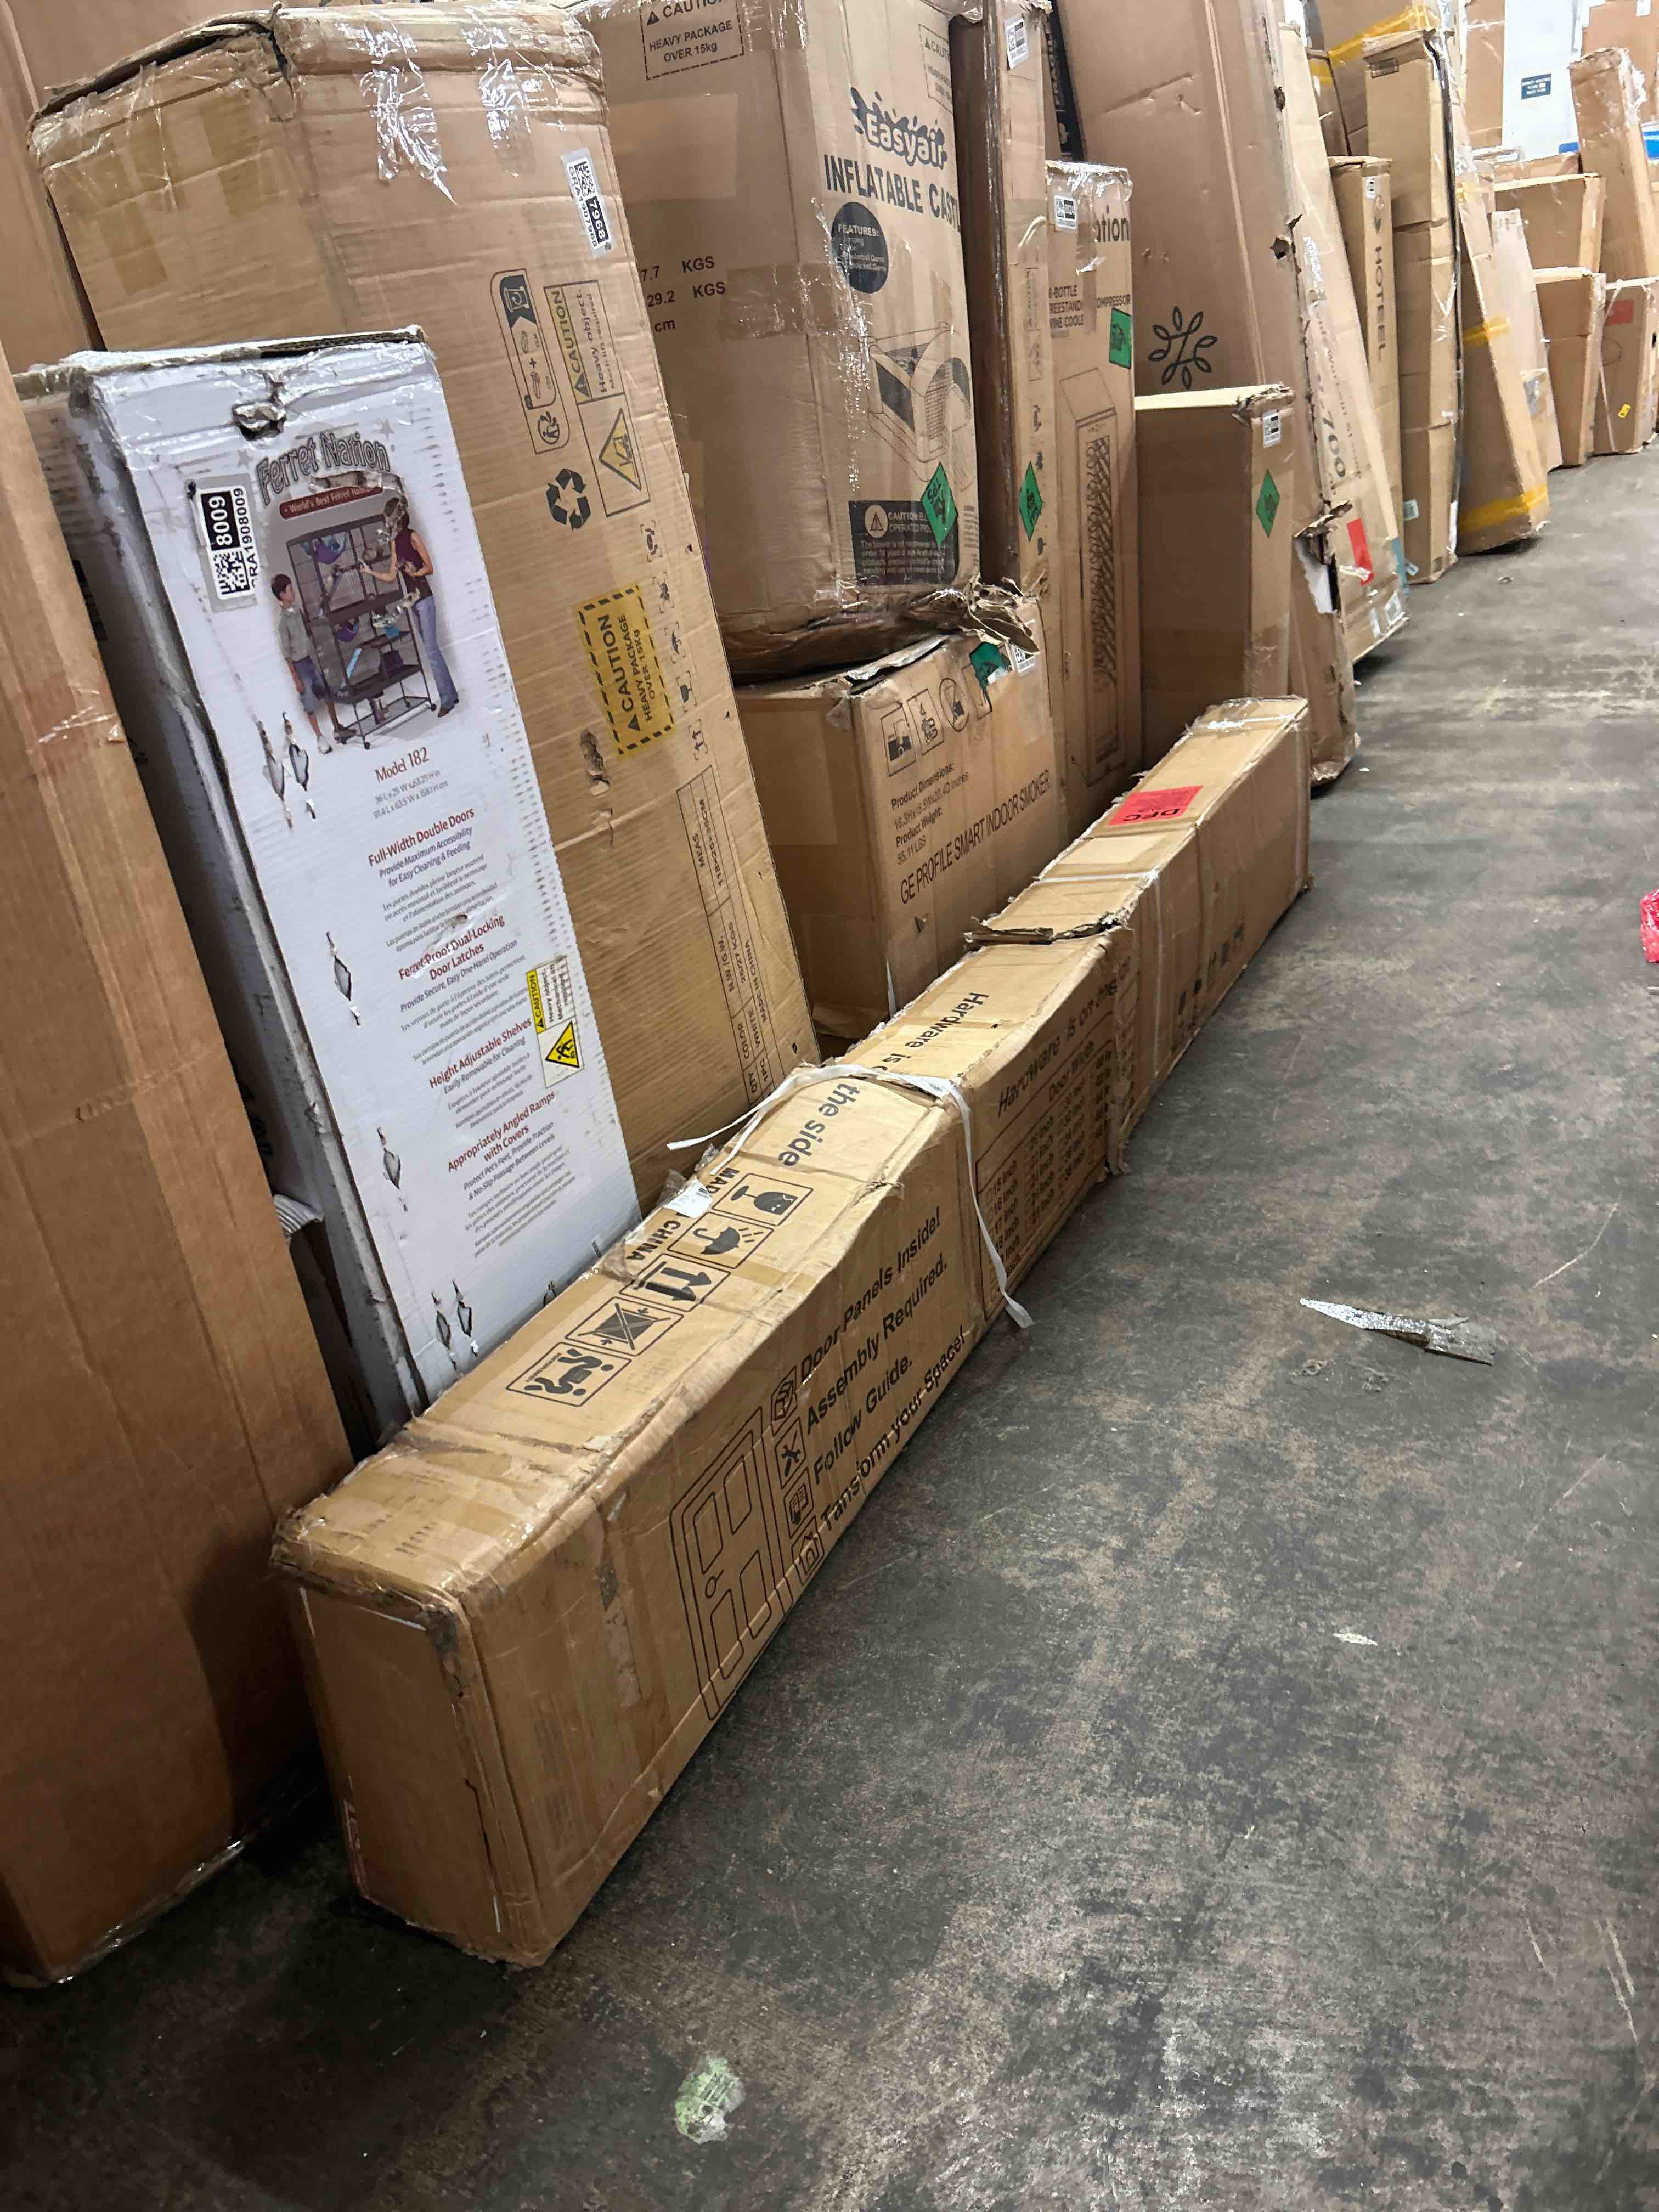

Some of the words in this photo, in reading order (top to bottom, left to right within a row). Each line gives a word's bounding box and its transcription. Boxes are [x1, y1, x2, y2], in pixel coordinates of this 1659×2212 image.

[663, 0, 726, 18] CAUTI
[649, 34, 681, 52] HEAVY
[684, 20, 732, 41] PACKAGE
[663, 48, 692, 62] OVER
[695, 42, 718, 54] 15kg
[931, 41, 949, 61] CAUT
[864, 110, 947, 170] Easyair
[568, 165, 599, 249] GRA1907968
[824, 154, 923, 213] INFLATABLE
[929, 183, 962, 232] CASTL
[589, 200, 607, 241] 7968
[838, 224, 879, 237] FEATURES:
[682, 256, 715, 273] KGS
[646, 290, 675, 308] 29.2
[693, 281, 726, 298] KGS
[1049, 300, 1080, 315] REESTAND
[1097, 294, 1131, 308] OMPRESSOR
[551, 290, 582, 375] CAUTION
[654, 320, 675, 332] cm
[1065, 314, 1084, 327] COOL
[588, 346, 608, 393] Heavy
[256, 437, 319, 506] Ferret
[320, 431, 391, 472] Nation
[208, 495, 232, 546] 8009
[596, 613, 635, 713] CAUTION
[617, 614, 640, 676] PACKAGE
[634, 678, 653, 721] HEAVY
[641, 664, 656, 699] OVER
[375, 759, 407, 783] Model
[409, 747, 430, 768] 182
[891, 786, 919, 811] Product
[368, 835, 417, 867] Full-Width
[416, 820, 449, 843] Double
[449, 808, 475, 830] Doors
[378, 858, 404, 878] Provide
[403, 843, 437, 866] Maximum
[436, 825, 473, 851] Accessibility
[692, 832, 706, 868] MEAS
[896, 822, 921, 848] Product
[900, 875, 915, 905] GE
[916, 842, 953, 892] PROFILE
[955, 818, 985, 861] SMART
[986, 799, 1018, 835] INDOOR
[1019, 769, 1051, 812] SMOKER
[387, 875, 399, 888] for
[398, 867, 414, 883] Easy
[413, 854, 442, 876] Cleaning
[446, 839, 471, 859] Feeding
[450, 913, 506, 953] Dual-Locking
[399, 991, 425, 1012] Provide
[445, 971, 461, 986] Easy
[489, 939, 518, 962] Operation
[428, 960, 452, 980] Door
[451, 941, 485, 968] Latches
[744, 939, 758, 976] CHINA
[528, 974, 541, 1018] CAUTION
[752, 976, 760, 989] IN
[755, 989, 768, 1022] MADE
[905, 992, 989, 1048] Hardware
[736, 1021, 751, 1059] COLOR
[747, 1008, 761, 1048] WHITE
[428, 1063, 459, 1090] Height
[458, 1036, 502, 1071] Adjustable
[501, 1017, 533, 1045] Shelves
[758, 1057, 769, 1082] 1PC
[883, 1053, 912, 1063] is
[997, 1036, 1060, 1116] Hardware
[817, 1083, 860, 1118] the
[446, 1126, 504, 1175] Appropriately
[501, 1107, 531, 1137] Angled
[528, 1089, 557, 1118] Ramps
[483, 1142, 503, 1162] with
[502, 1124, 529, 1149] Covers
[778, 1119, 826, 1167] side
[706, 1167, 740, 1194] MAD
[625, 1220, 681, 1260] CHINA
[800, 1325, 841, 1380] Door
[843, 1266, 893, 1332] Panels
[897, 1206, 940, 1273] Inside!
[807, 1332, 879, 1436] Assembly
[882, 1252, 947, 1339] Required.
[891, 1387, 923, 1444] your
[924, 1325, 966, 1393] Space!
[814, 1409, 862, 1485] Follow
[866, 1356, 913, 1414] Guide.
